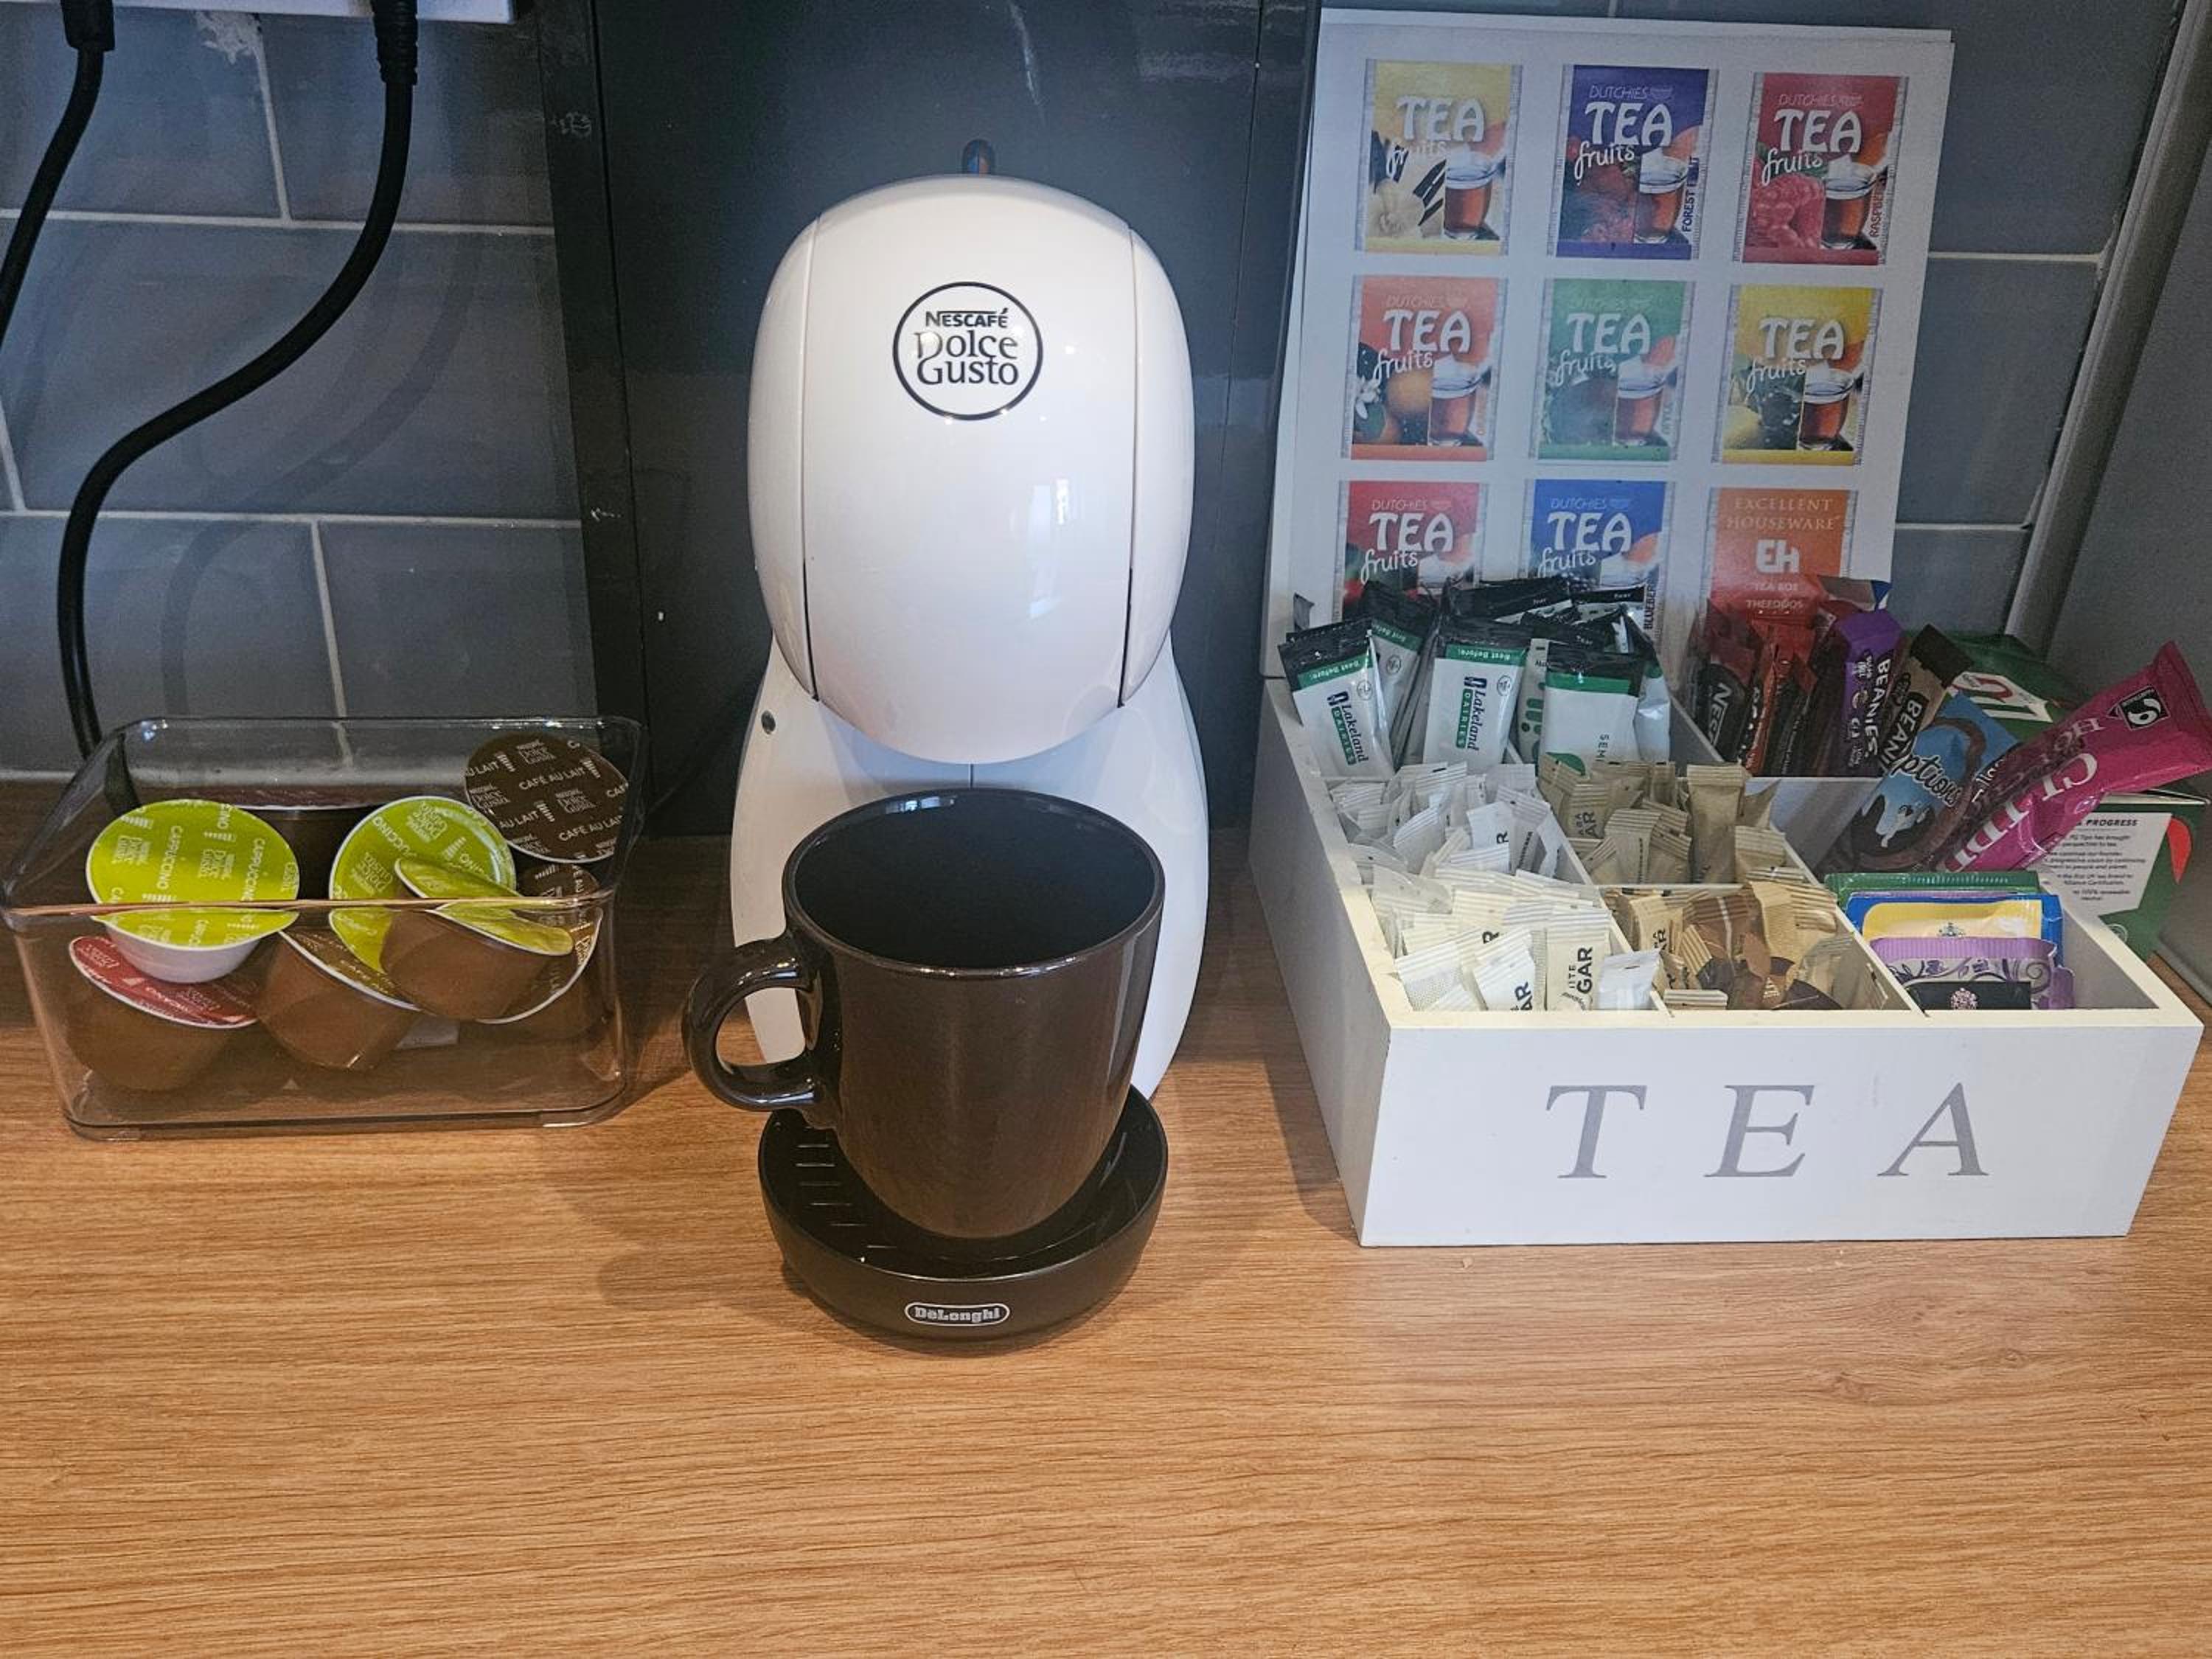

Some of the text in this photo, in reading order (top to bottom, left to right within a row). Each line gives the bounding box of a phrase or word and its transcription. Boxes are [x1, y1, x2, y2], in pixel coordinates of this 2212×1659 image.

[1396, 94, 1487, 143] TEA
[1585, 101, 1673, 147] TEA
[1773, 108, 1863, 153] TEA
[1573, 141, 1635, 183] fruits
[1761, 147, 1823, 185] fruits
[1681, 189, 1696, 232] FOREST
[925, 307, 1008, 328] NESCAFÉ
[1382, 308, 1472, 353] TEA
[1566, 312, 1652, 354] TEA
[914, 330, 1019, 359] Dolce
[1759, 317, 1845, 360] TEA
[917, 356, 1019, 385] Gusto
[1373, 347, 1433, 386] fruits
[1556, 349, 1616, 387] fruits
[1745, 355, 1806, 403] fruits
[1734, 497, 1833, 511] EXCELLENT
[1368, 512, 1454, 552] TEA
[1548, 511, 1632, 552] TEA
[1360, 548, 1418, 585] fruits
[1537, 546, 1596, 579] fruits
[1341, 703, 1369, 762] Lakeland
[1468, 689, 1487, 751] Lakeland
[565, 767, 585, 779] LAIT
[516, 810, 540, 825] LAIT
[2086, 818, 2138, 827] PROGRESS
[157, 825, 184, 890] CAPPUCCINO
[1576, 946, 1593, 994] GAR
